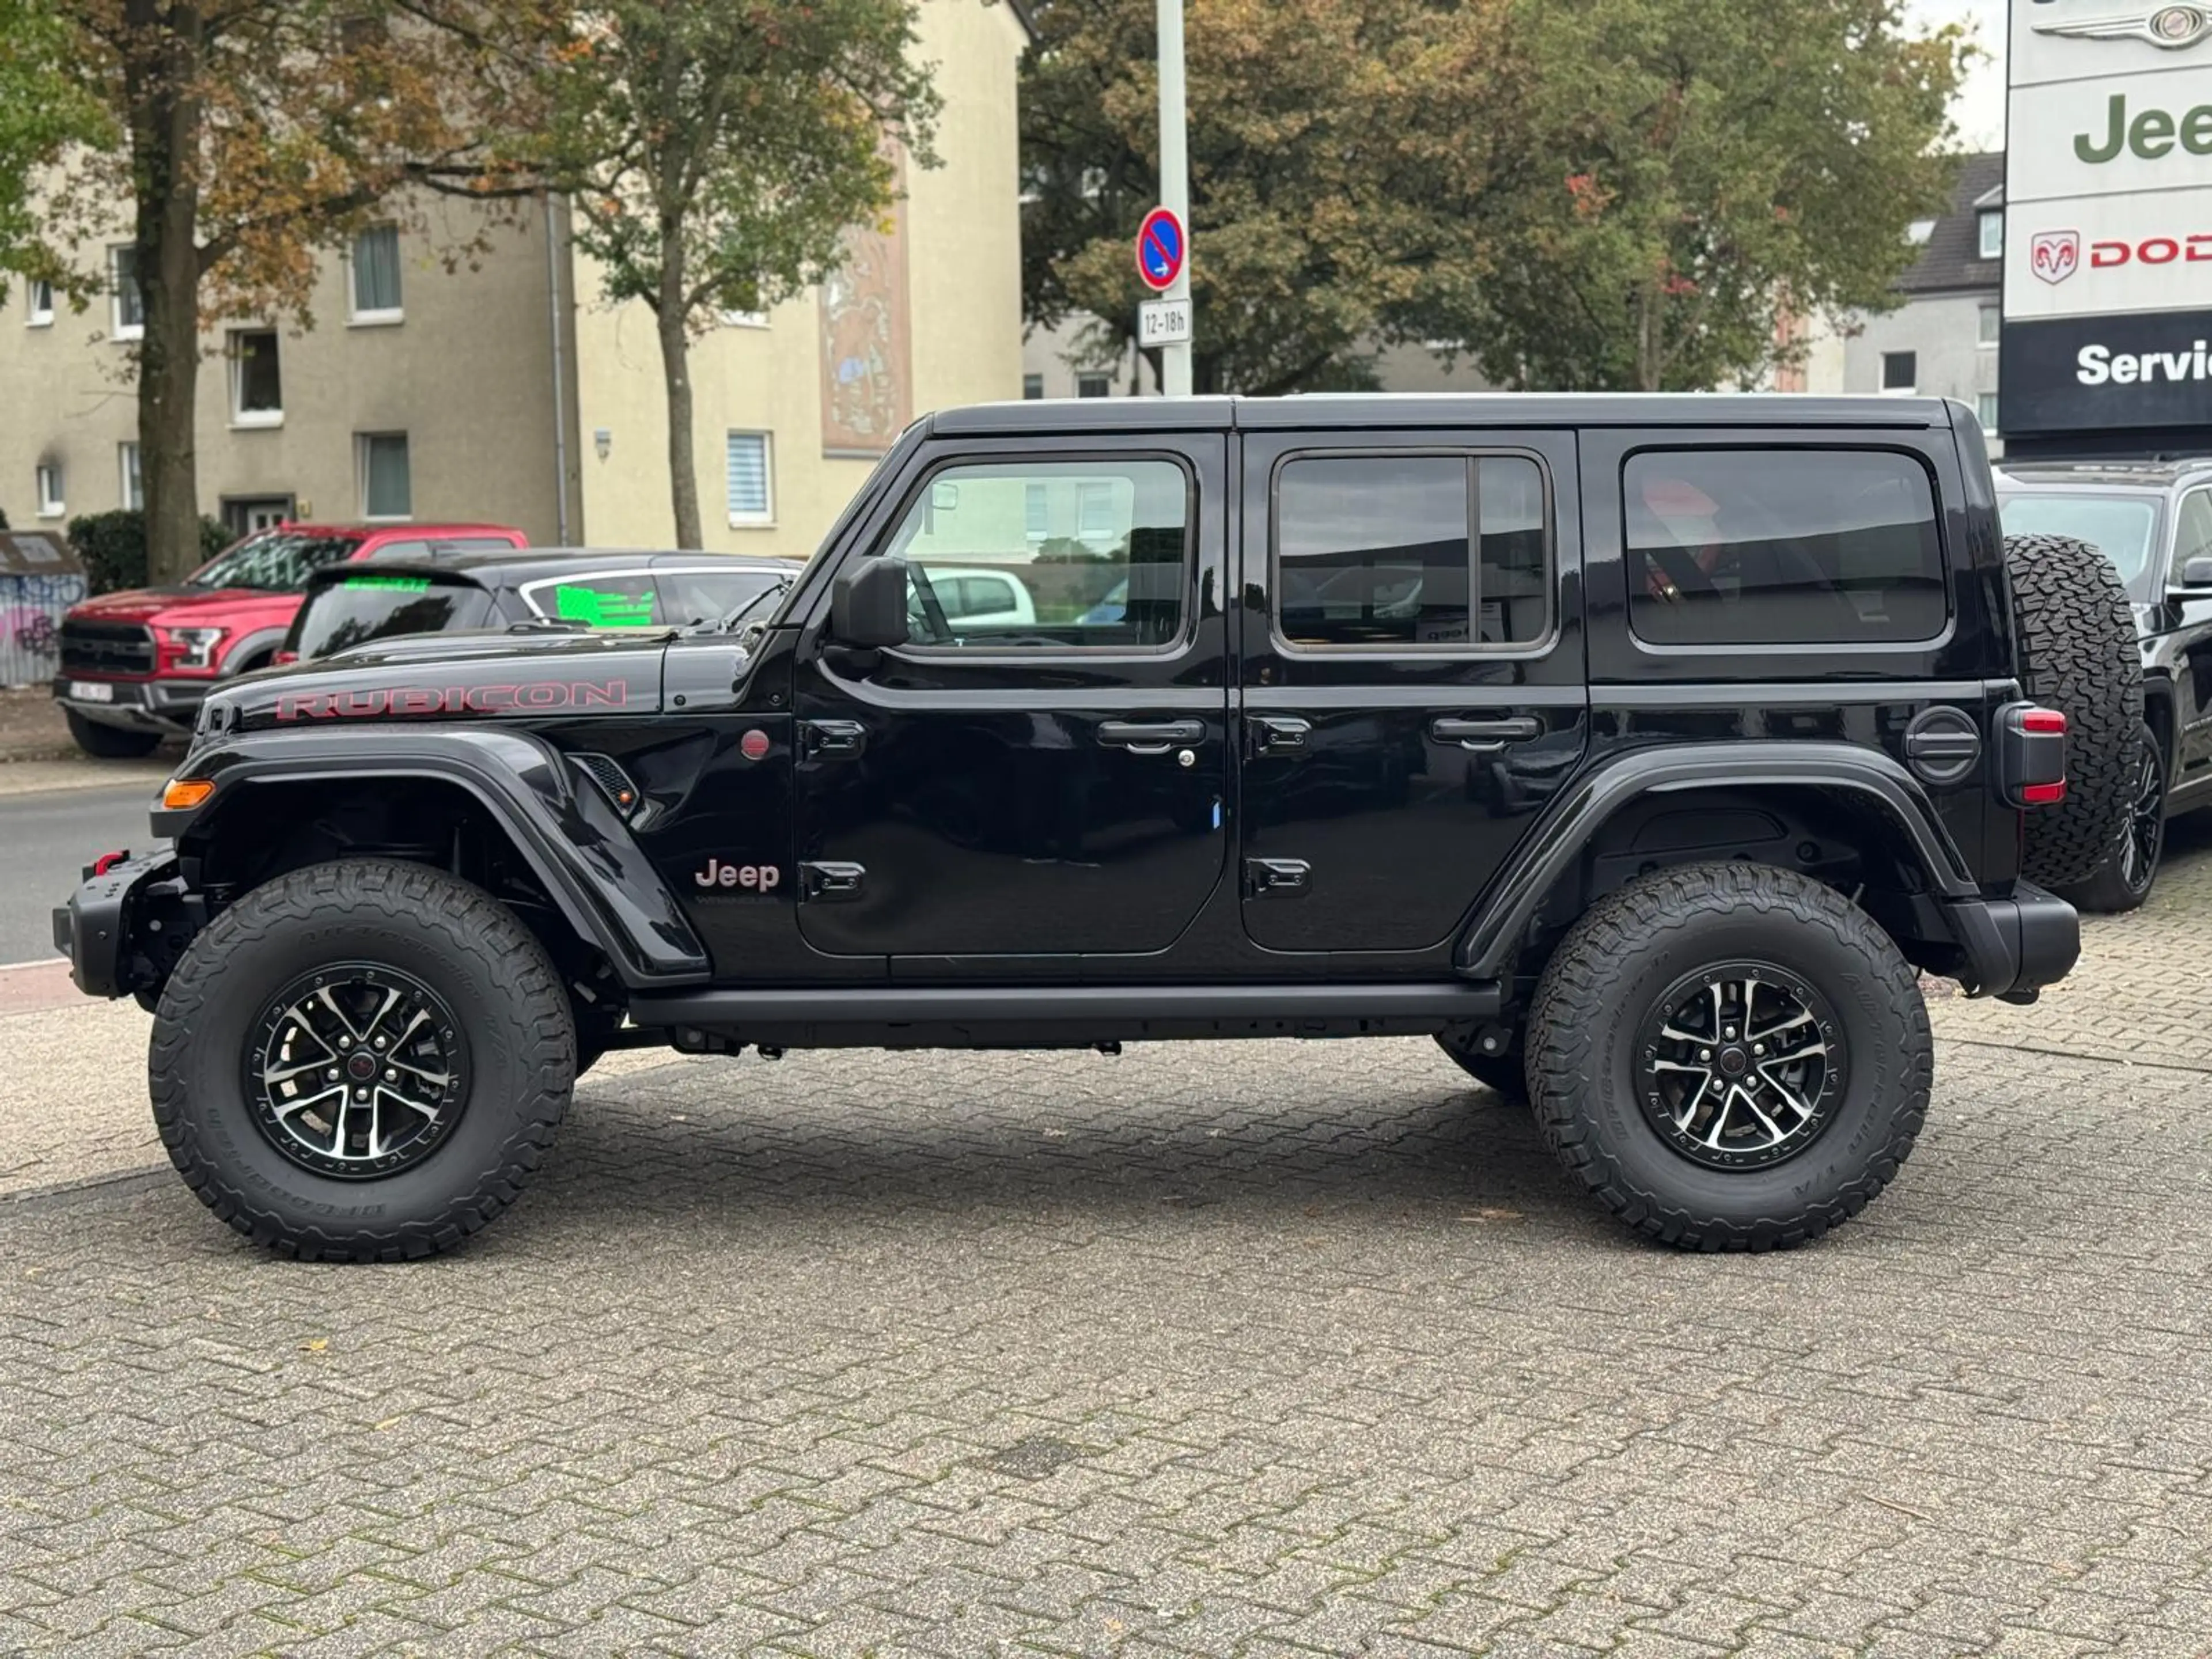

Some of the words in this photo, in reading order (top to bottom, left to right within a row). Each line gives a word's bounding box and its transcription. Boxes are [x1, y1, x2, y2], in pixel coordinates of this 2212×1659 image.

[2076, 340, 2212, 385] Servi
[275, 680, 627, 720] RUBICON
[695, 859, 779, 892] Jeep
